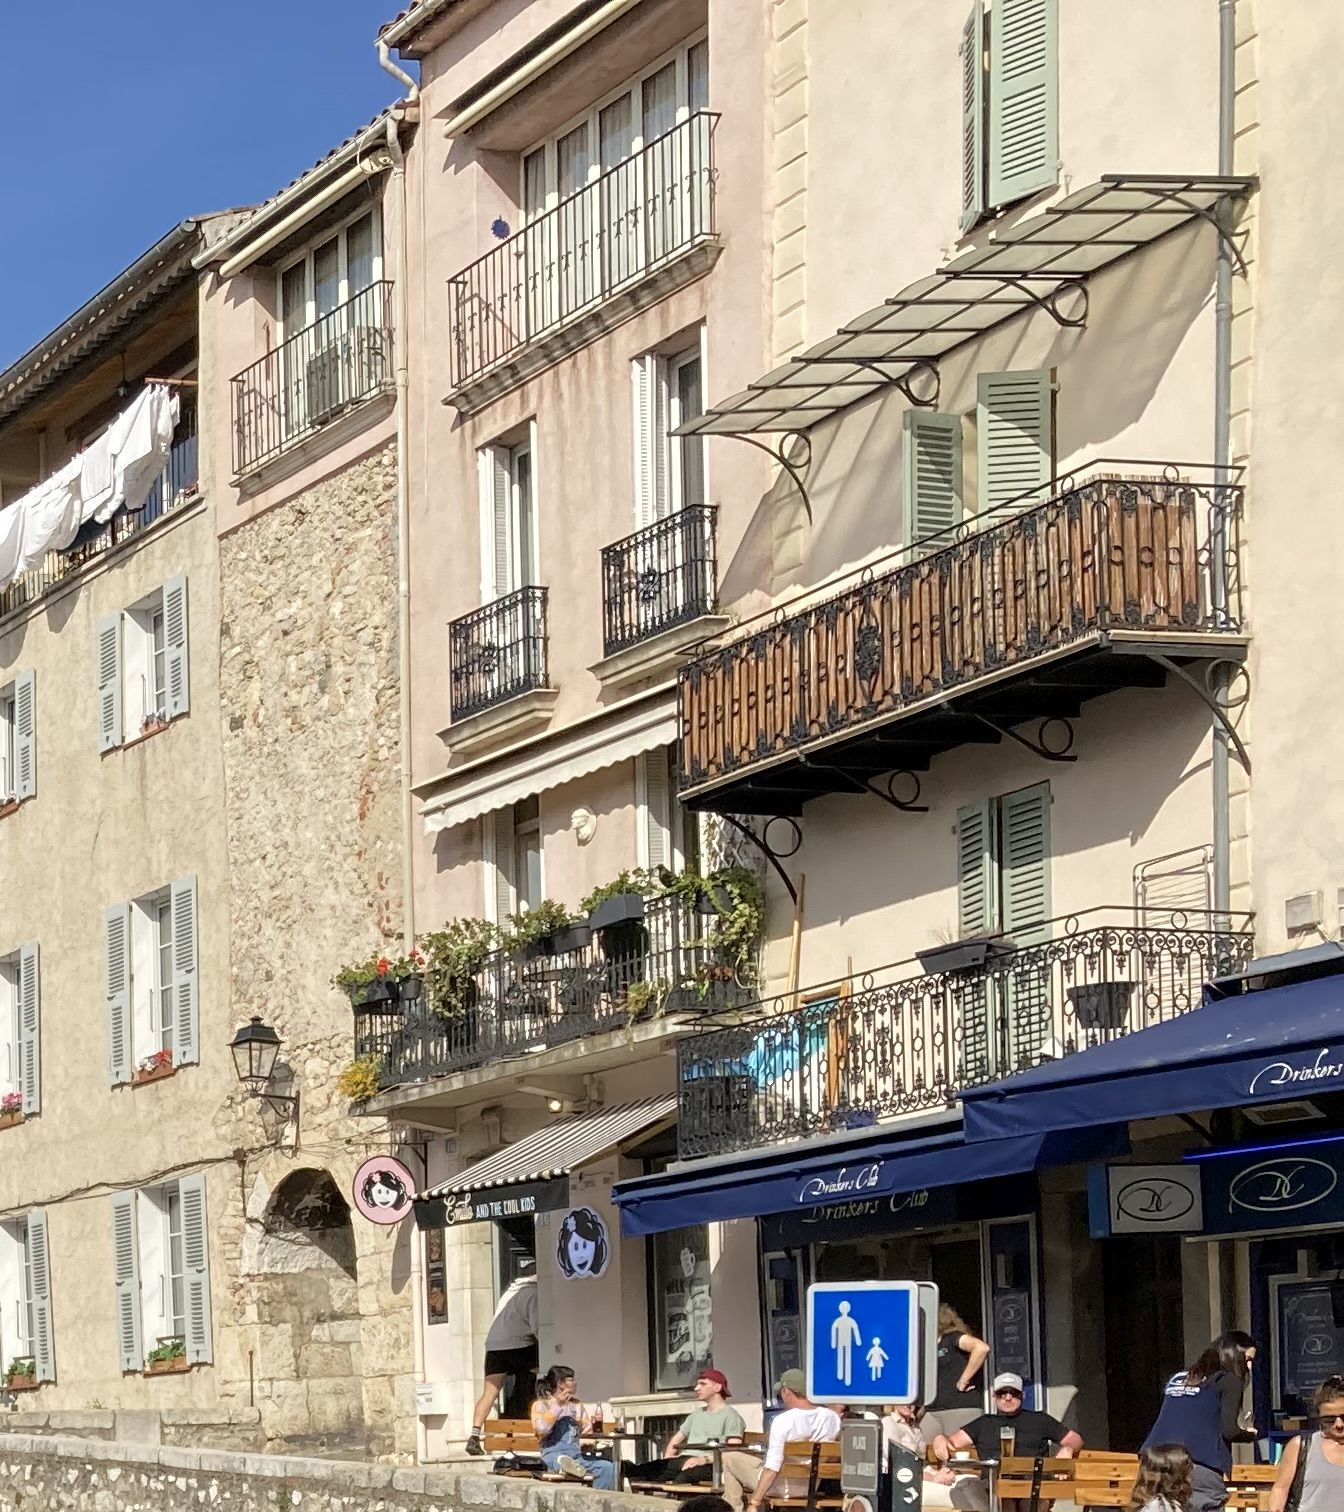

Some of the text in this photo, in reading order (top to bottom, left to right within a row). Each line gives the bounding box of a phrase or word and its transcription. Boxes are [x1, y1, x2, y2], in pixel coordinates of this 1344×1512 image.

[1250, 1048, 1343, 1093] Drinkers
[799, 1161, 885, 1202] Drinkers Club
[476, 1204, 489, 1218] AND
[490, 1201, 502, 1216] THE
[504, 1199, 519, 1215] COOL
[521, 1196, 536, 1211] KIDS
[801, 1189, 929, 1223] Drinkers Club
